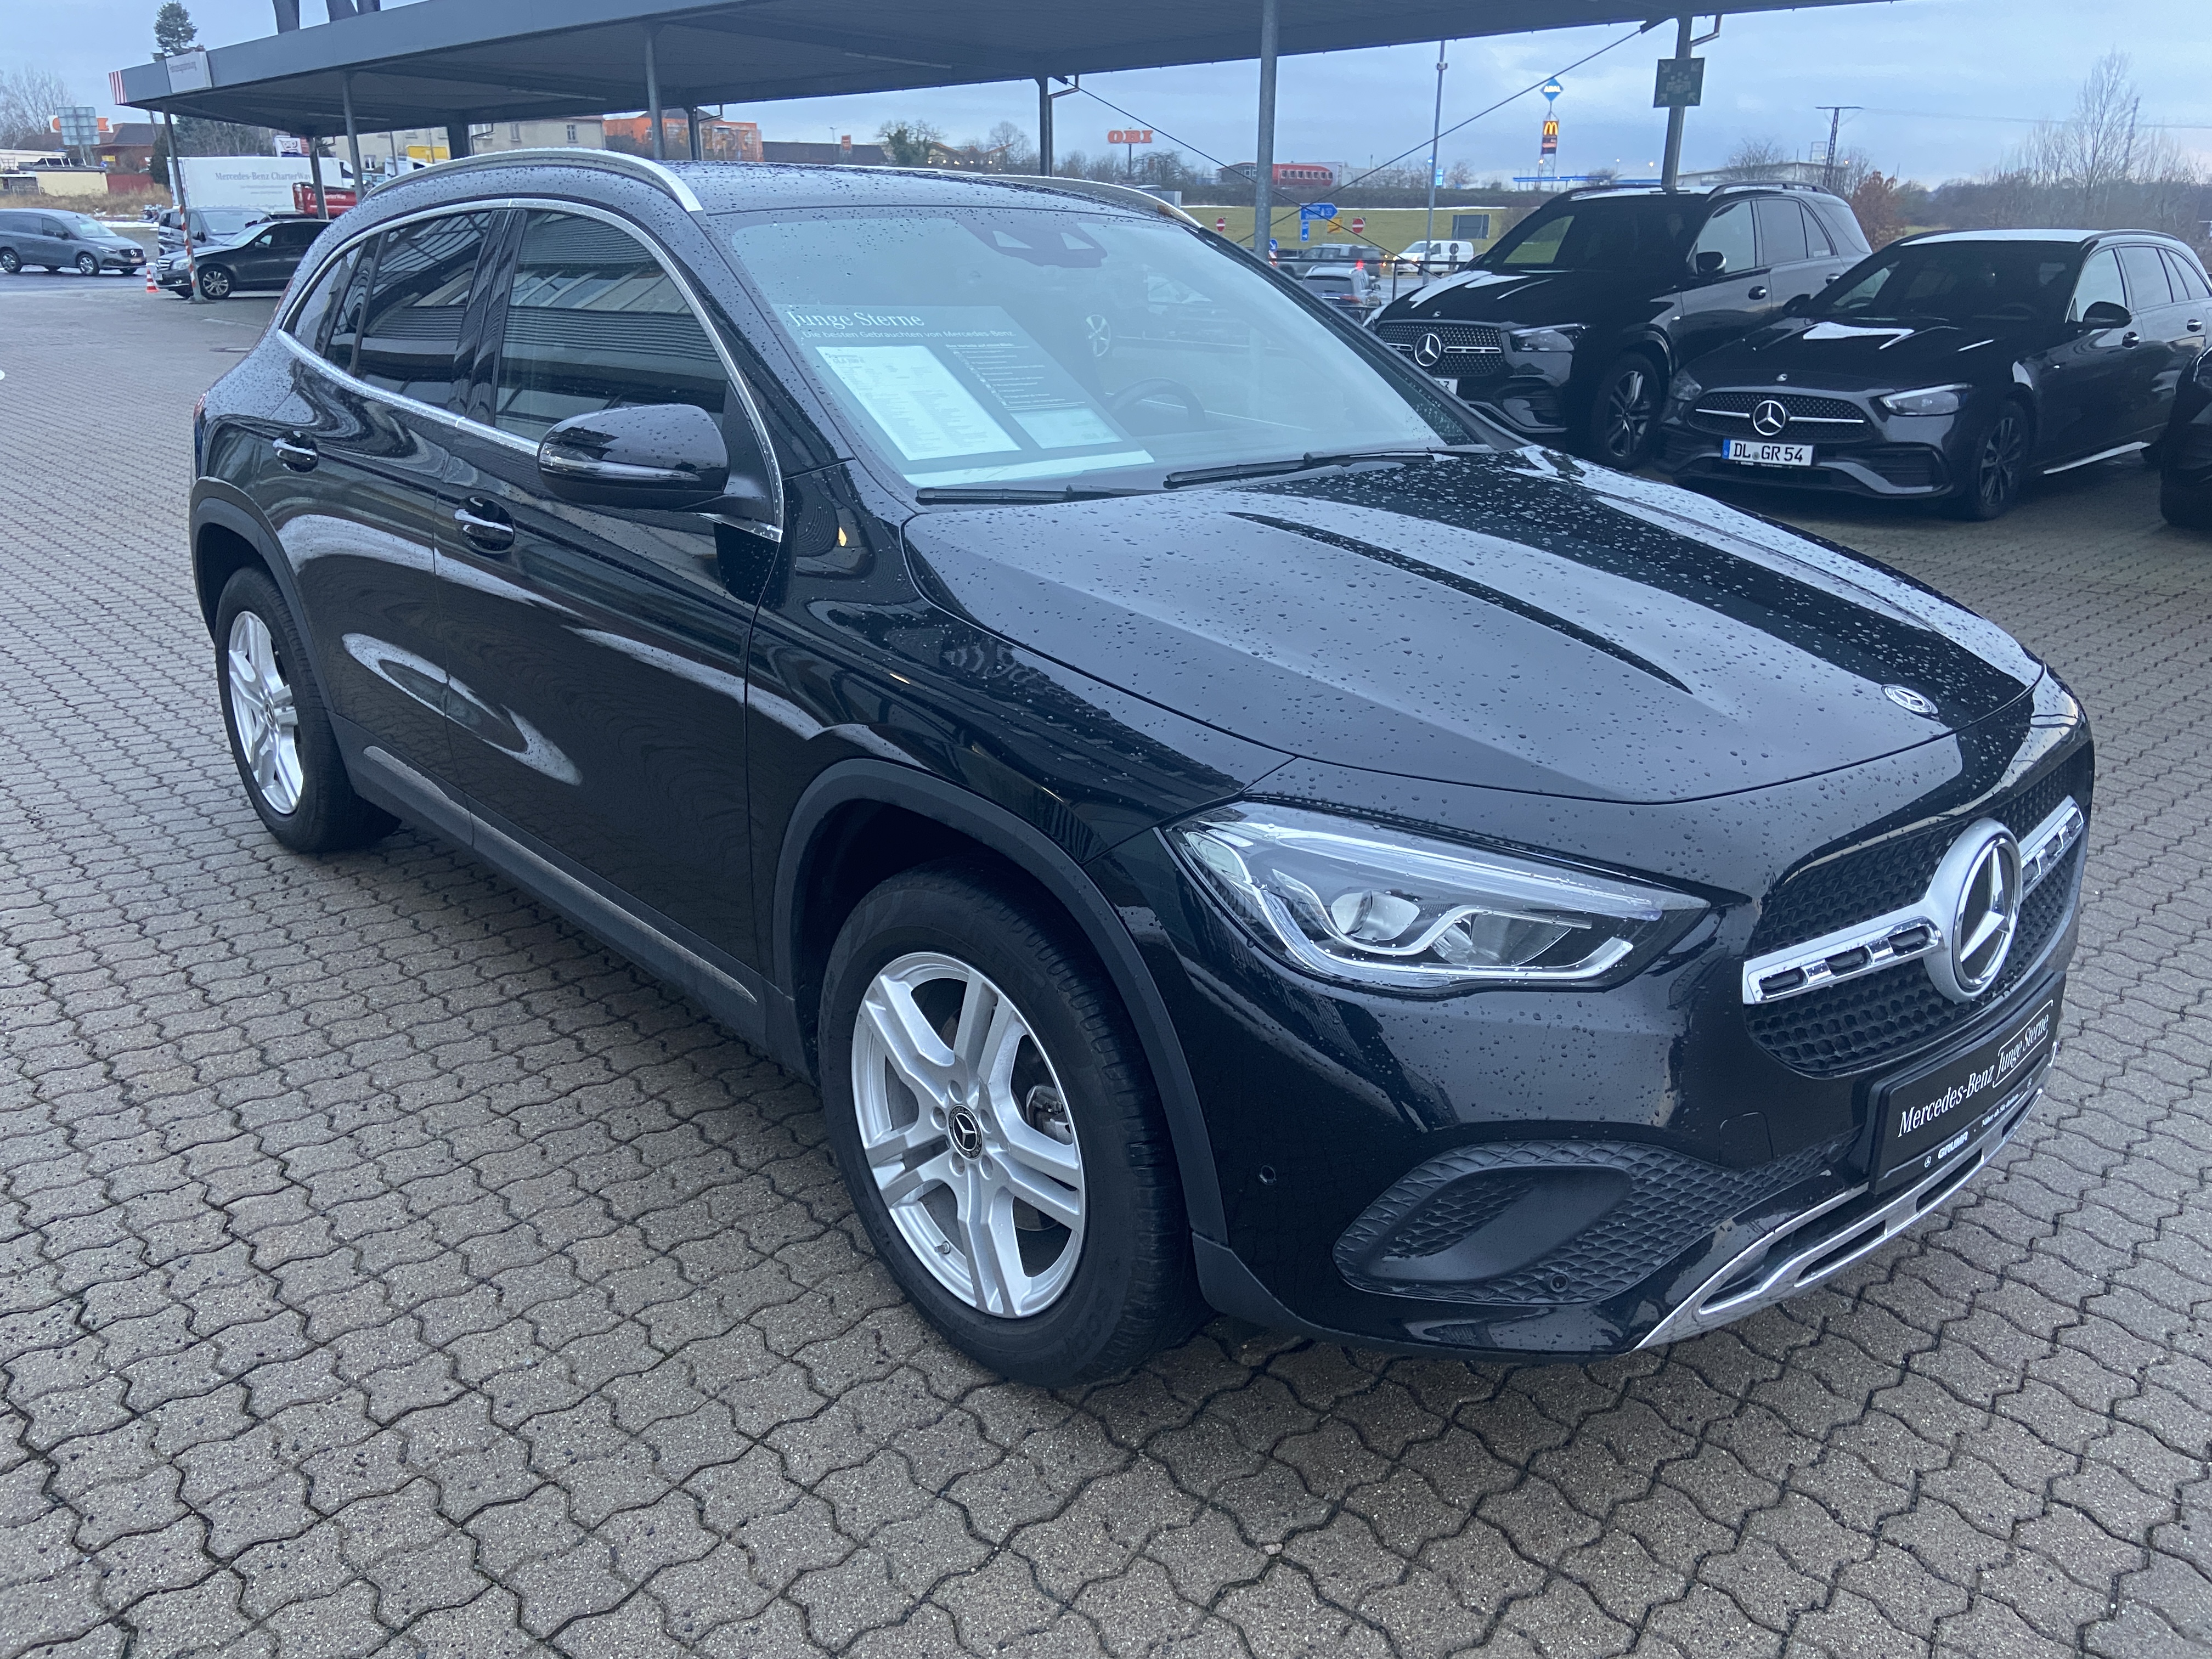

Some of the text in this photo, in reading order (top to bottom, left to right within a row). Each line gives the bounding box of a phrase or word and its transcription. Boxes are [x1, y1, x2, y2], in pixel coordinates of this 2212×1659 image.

[1108, 130, 1153, 143] OBI
[787, 311, 924, 330] Junge Sterne
[1734, 442, 1803, 463] DL GR 54
[1898, 1014, 2049, 1137] Mercedes-Benz Junge Sterne
